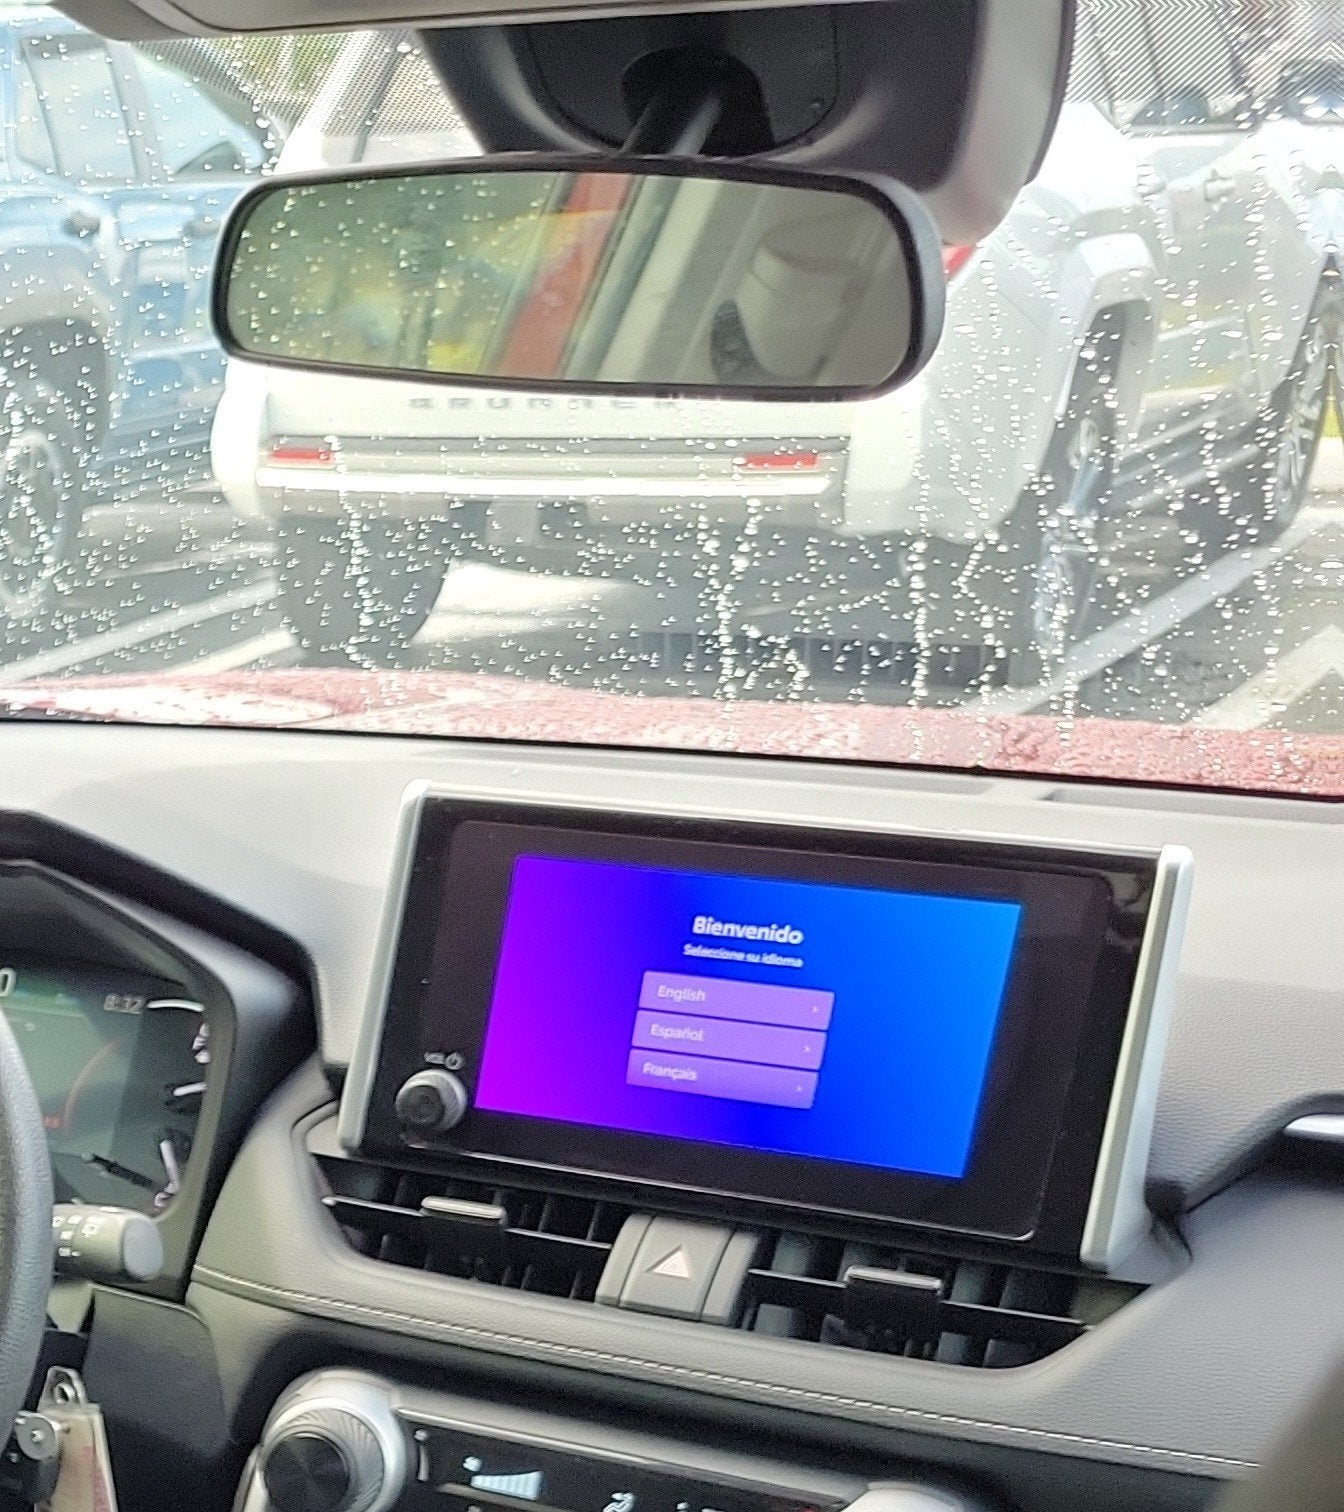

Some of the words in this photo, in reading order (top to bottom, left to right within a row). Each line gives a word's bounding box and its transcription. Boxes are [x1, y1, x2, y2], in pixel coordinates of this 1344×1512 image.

[692, 915, 804, 945] Bienvenido
[682, 943, 745, 962] Seleccione
[761, 952, 804, 968] idioma
[657, 985, 706, 1002] English
[650, 1023, 704, 1042] Español
[642, 1062, 697, 1082] Français
